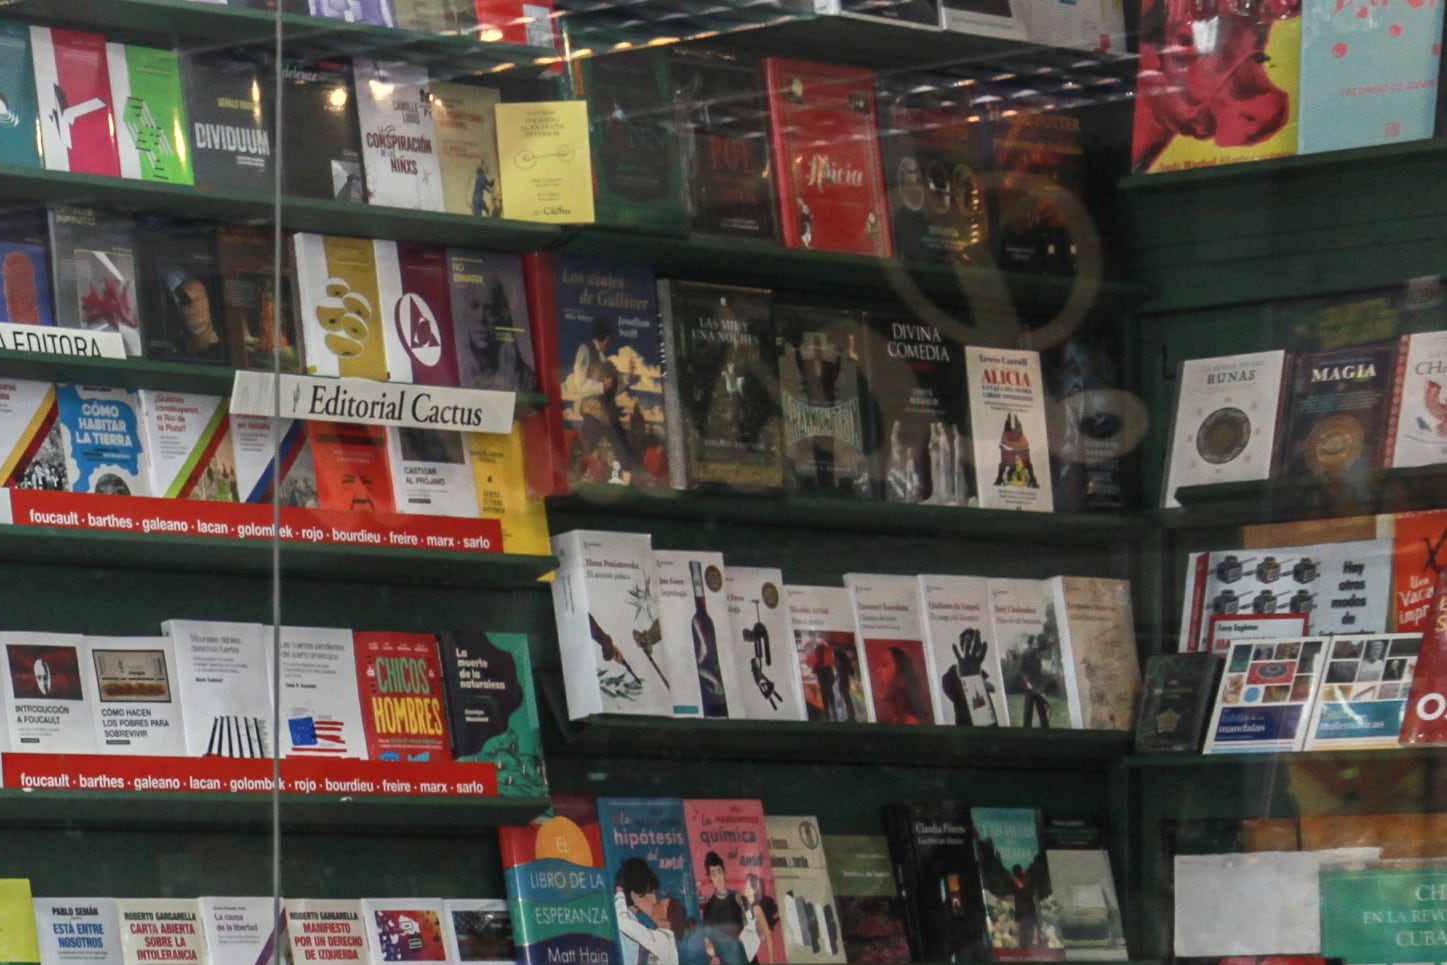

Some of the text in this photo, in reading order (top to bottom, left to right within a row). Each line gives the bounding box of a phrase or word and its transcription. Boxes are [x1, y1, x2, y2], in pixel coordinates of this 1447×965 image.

[194, 123, 270, 156] DIVIDUUM
[367, 132, 432, 154] CONSPIRACIÓN
[892, 323, 941, 344] DIVINA
[887, 341, 949, 362] COMEDIA
[1207, 371, 1256, 384] RUNAS
[1312, 365, 1376, 382] MAGIA
[82, 403, 119, 416] CÓMO
[309, 385, 482, 426] Editorial Cactus
[79, 419, 127, 432] HABITAR
[76, 432, 132, 447] LA TIERRA
[30, 509, 489, 549] foucault barthes galeano lacan rojo bourdieu freire marx sarlo
[375, 656, 430, 694] CHICOS
[371, 698, 443, 736] HOMBRES
[21, 773, 483, 794] foucault barthes galeano lacan rojo bourdieu freire marx sarlo
[613, 828, 684, 848] hipótesis
[700, 829, 756, 845] química
[530, 871, 604, 889] LIBRO DE LA
[535, 908, 609, 924] ESPERANZA
[130, 922, 195, 935] CARTA ABIERTA
[303, 922, 351, 934] MANIFIESTO
[145, 935, 186, 948] SOBRE LA
[295, 936, 362, 947] POR UN DERECHO
[138, 948, 197, 961] INTOLERANCIA
[305, 948, 358, 961] DE IZQUIERDA
[548, 948, 608, 965] Matt Haig
